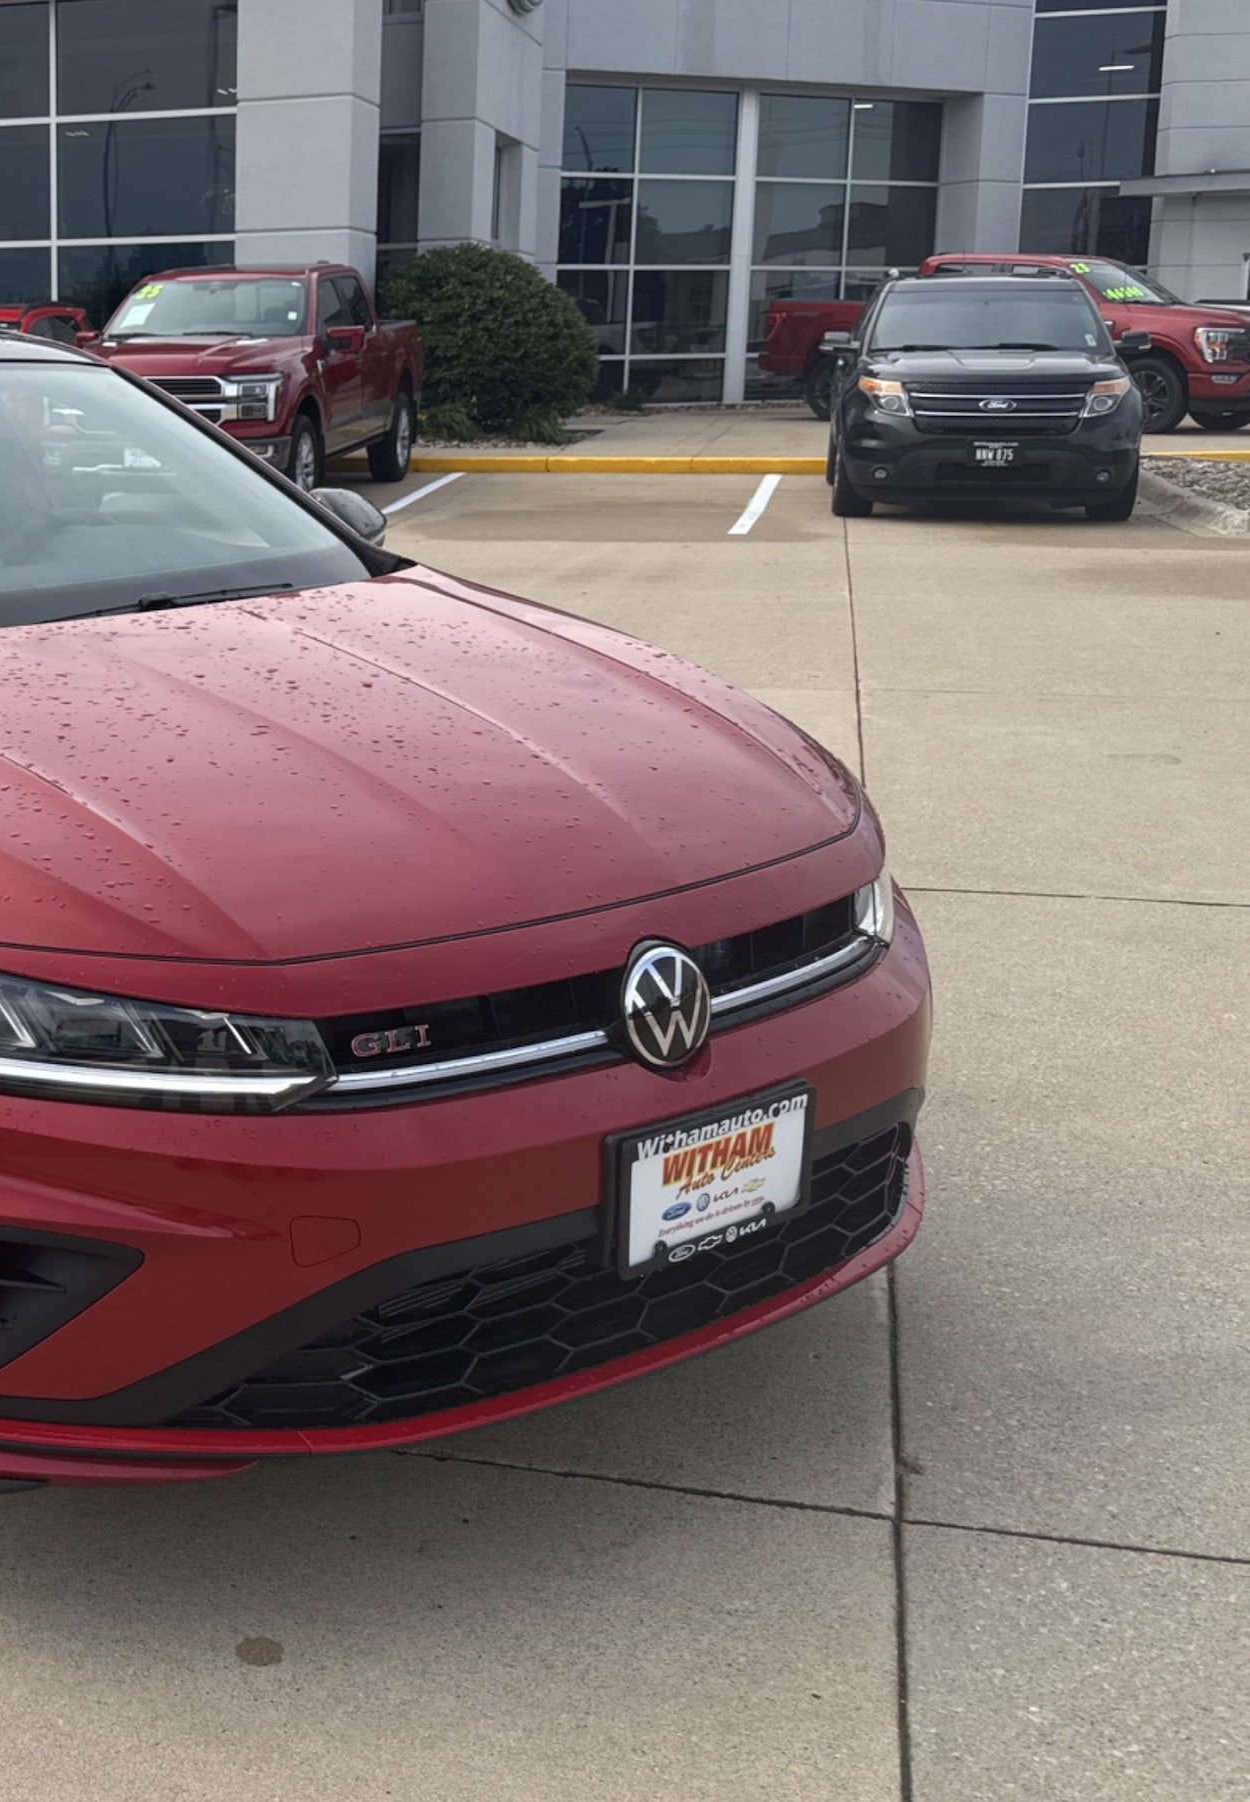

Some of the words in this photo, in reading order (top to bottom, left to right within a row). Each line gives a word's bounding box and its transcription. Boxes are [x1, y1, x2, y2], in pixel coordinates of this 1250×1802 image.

[351, 1024, 431, 1058] GLI
[661, 1122, 775, 1188] WITHAM
[676, 1171, 715, 1200] Auto
[720, 1146, 776, 1181] Centers
[658, 1219, 694, 1238] Everything
